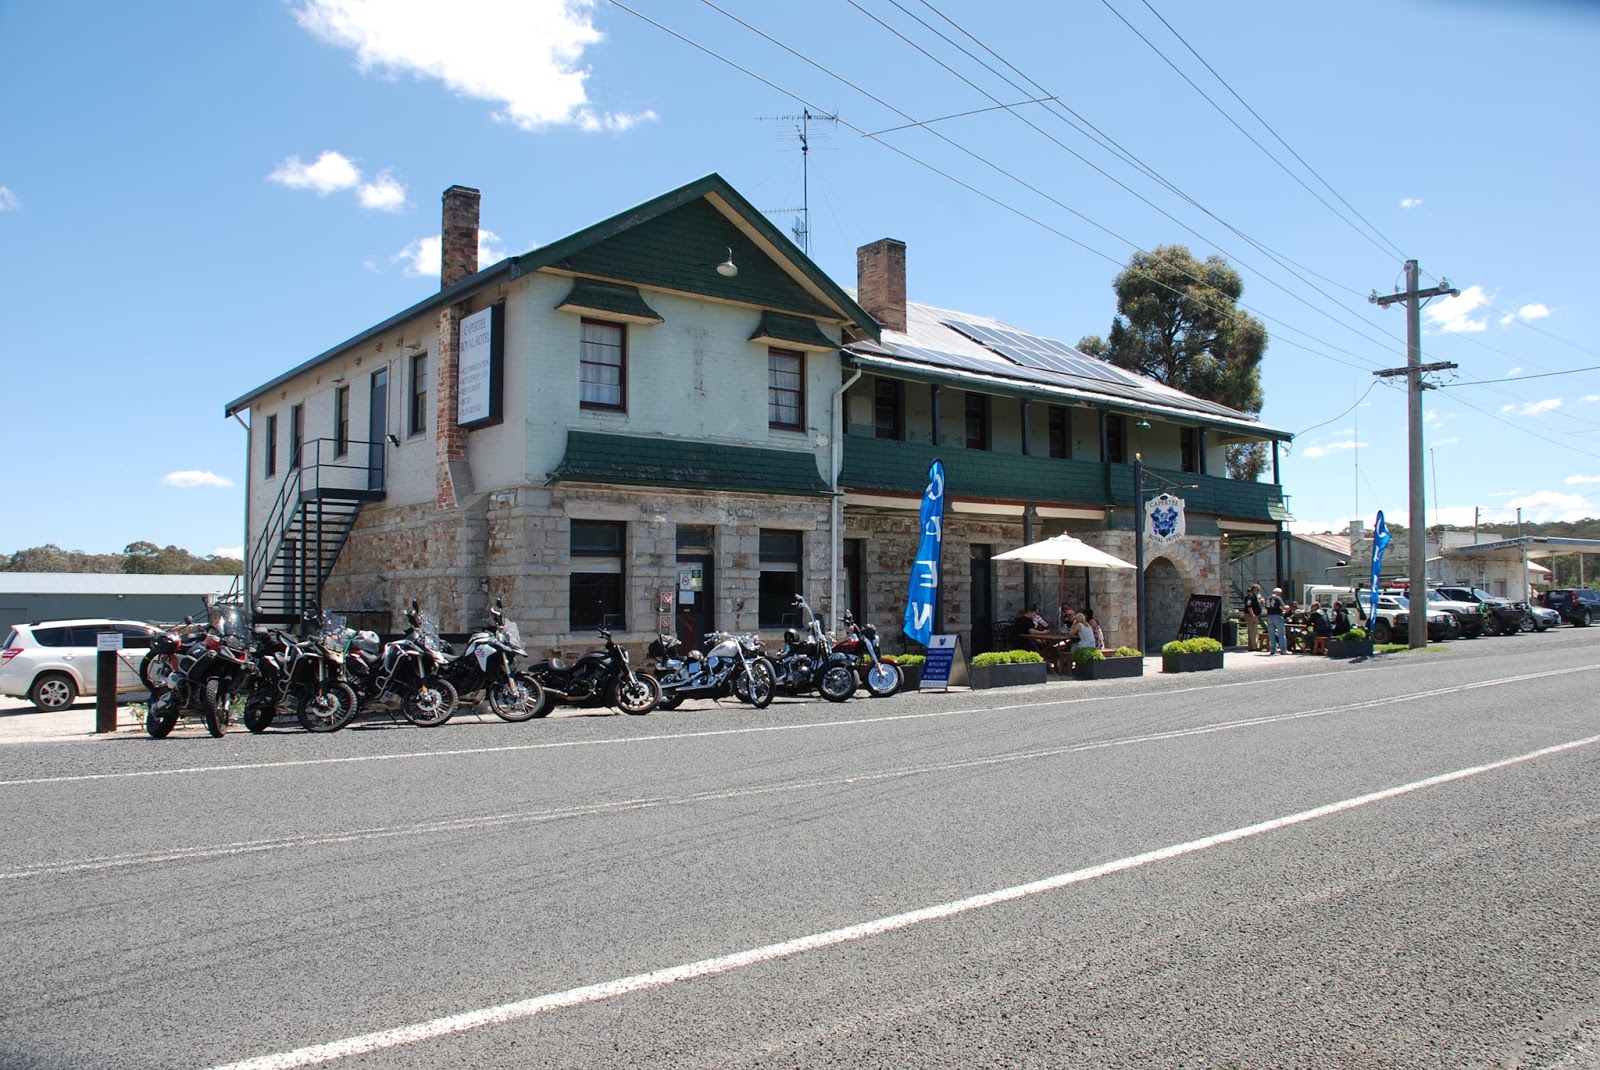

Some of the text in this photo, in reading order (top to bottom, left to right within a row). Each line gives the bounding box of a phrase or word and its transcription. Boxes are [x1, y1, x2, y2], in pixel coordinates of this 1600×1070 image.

[461, 332, 489, 352] ROYAL HOTEL
[1148, 532, 1182, 542] ROYAL HOTEL
